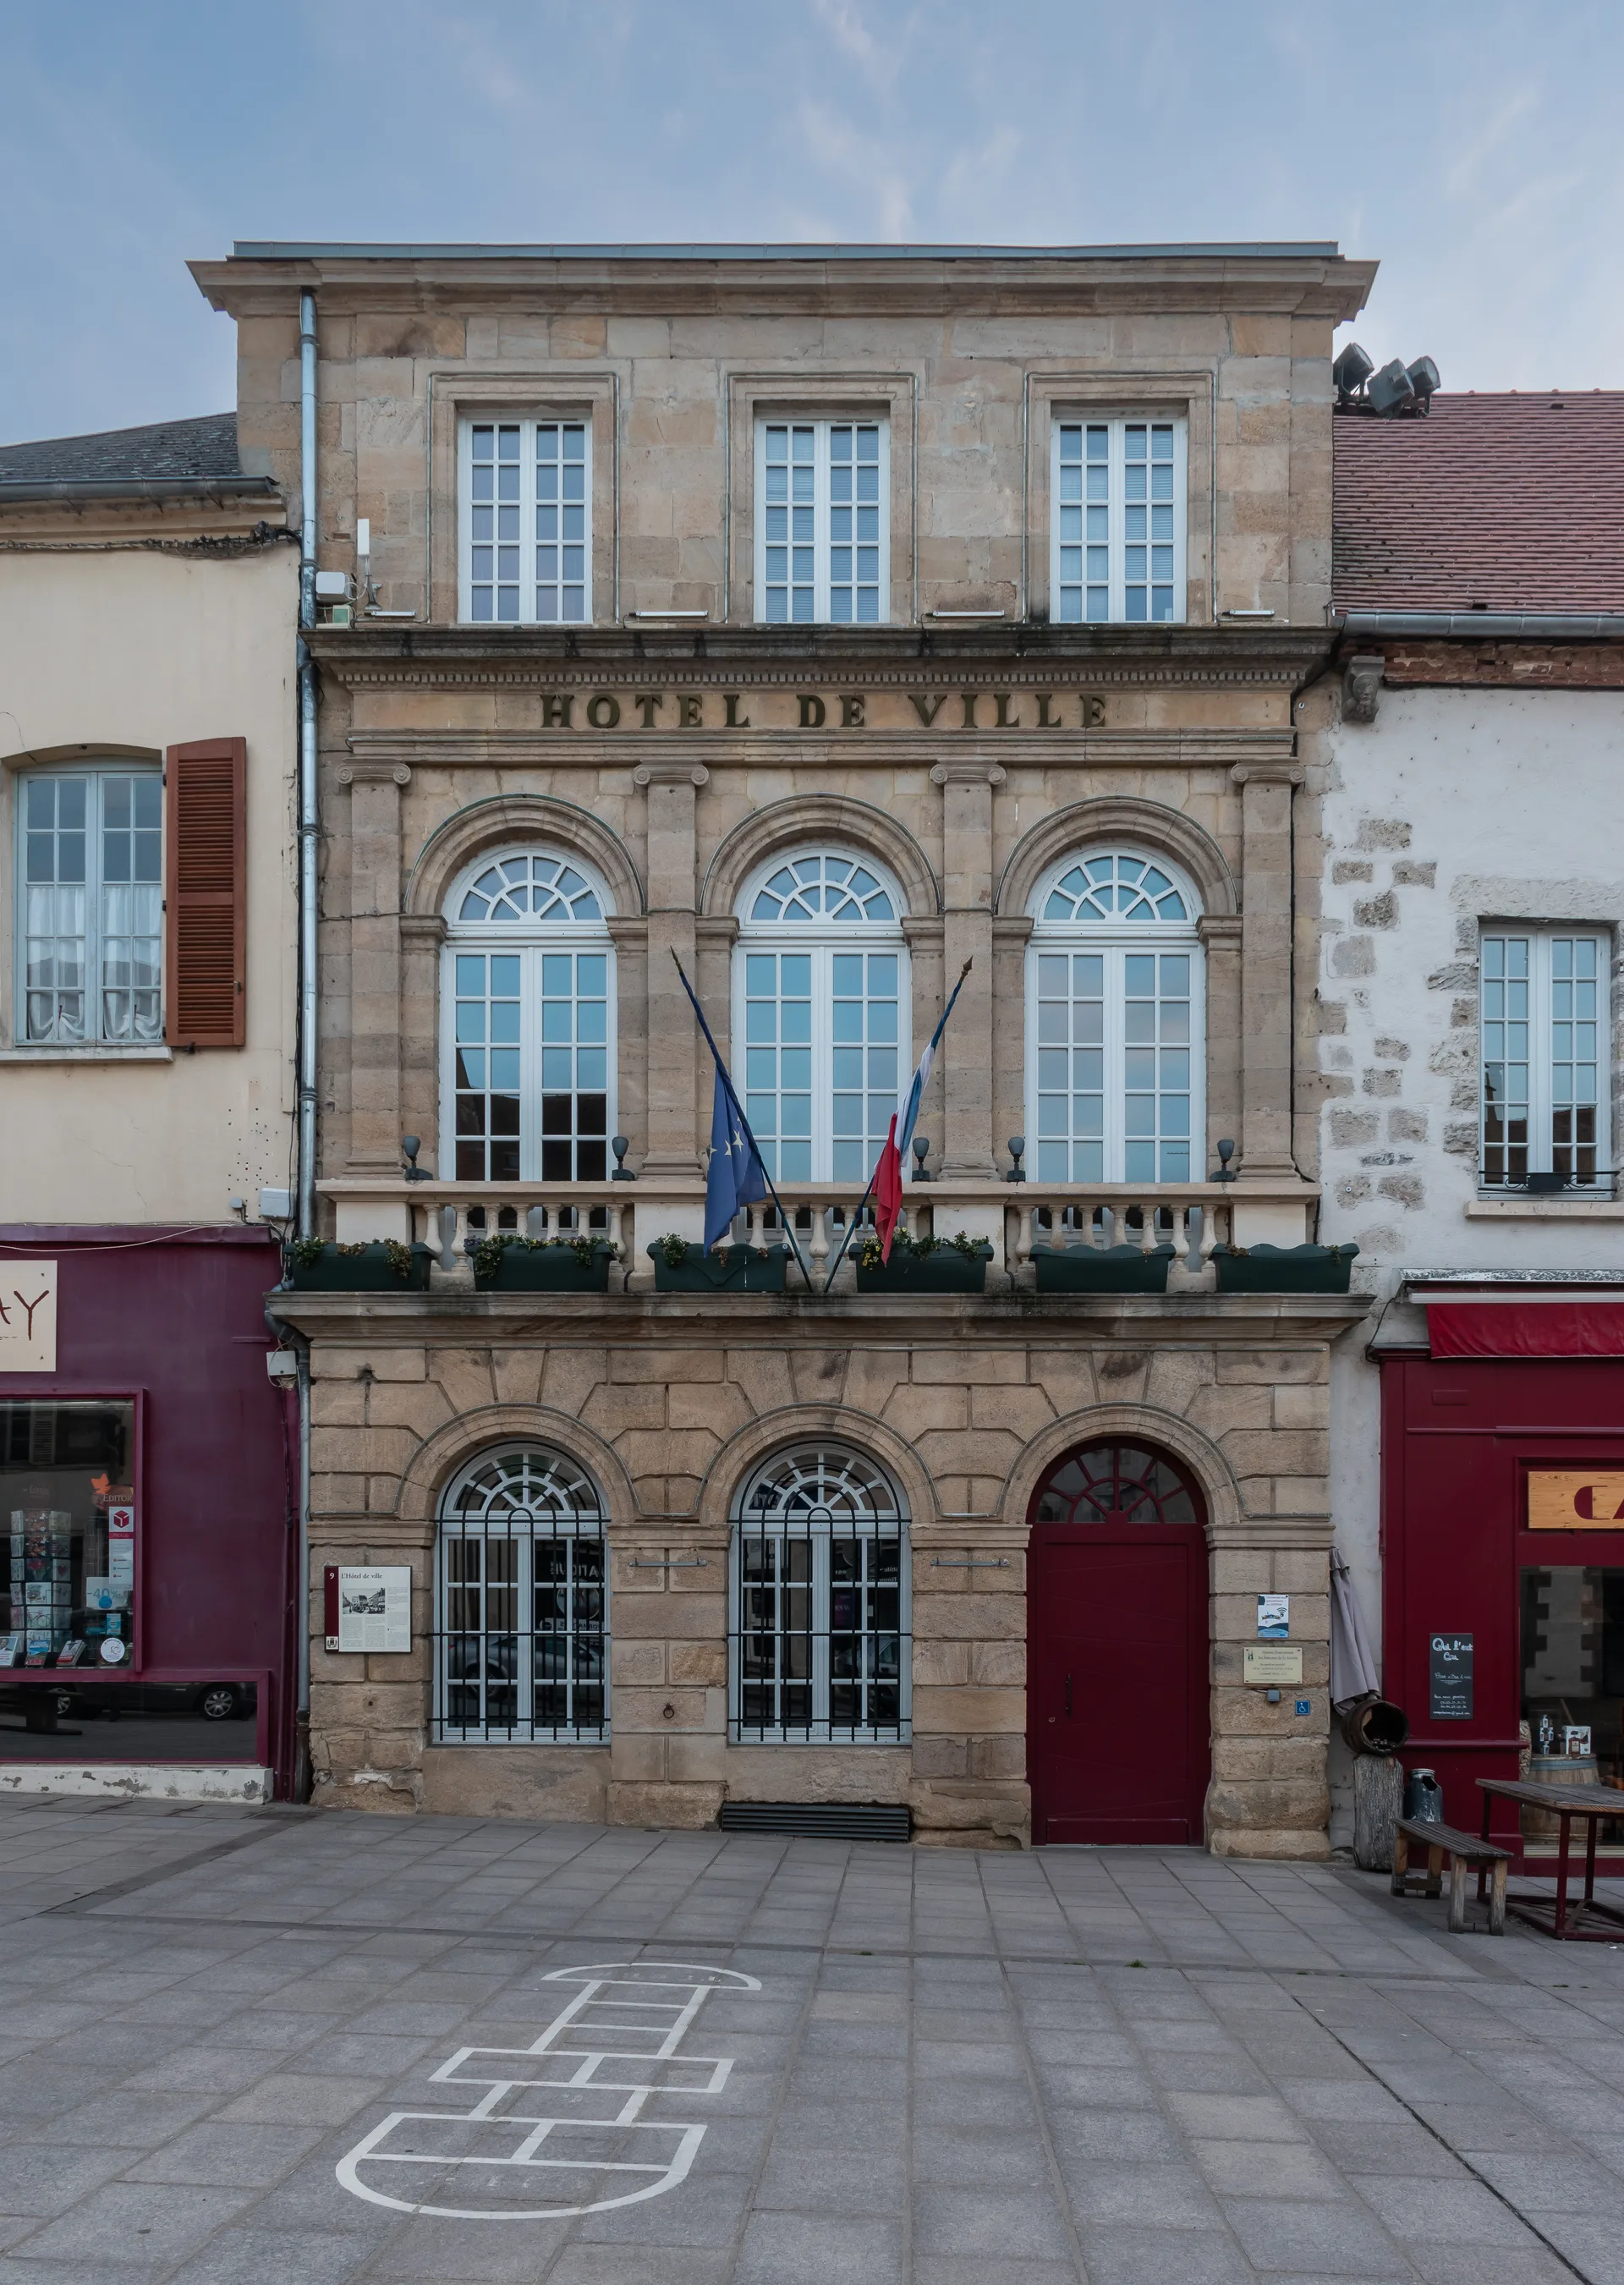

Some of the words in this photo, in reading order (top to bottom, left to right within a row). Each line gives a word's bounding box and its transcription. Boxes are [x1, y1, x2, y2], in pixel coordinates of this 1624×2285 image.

[540, 694, 750, 729] HOTEL
[797, 694, 866, 729] DE
[908, 694, 1107, 729] VILLE
[1573, 1485, 1624, 1520] C
